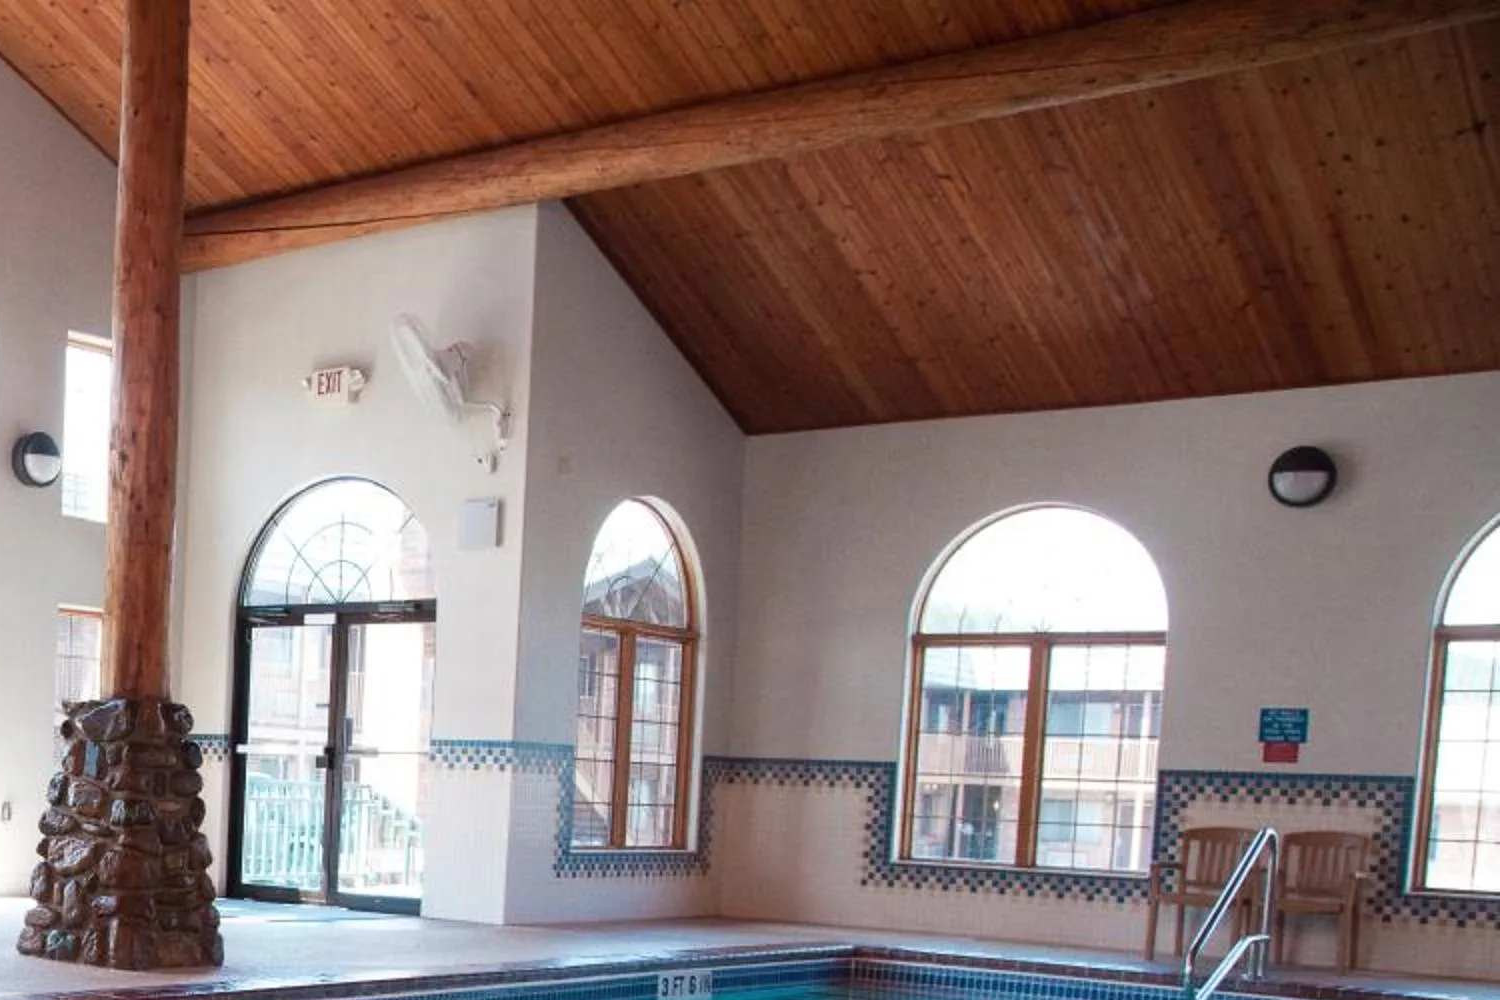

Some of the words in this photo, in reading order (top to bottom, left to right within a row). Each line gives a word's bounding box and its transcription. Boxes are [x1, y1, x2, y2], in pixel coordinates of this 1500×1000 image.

[317, 371, 342, 395] EXIT
[661, 977, 669, 997] 3
[672, 976, 685, 997] FT
[688, 975, 697, 995] 6
